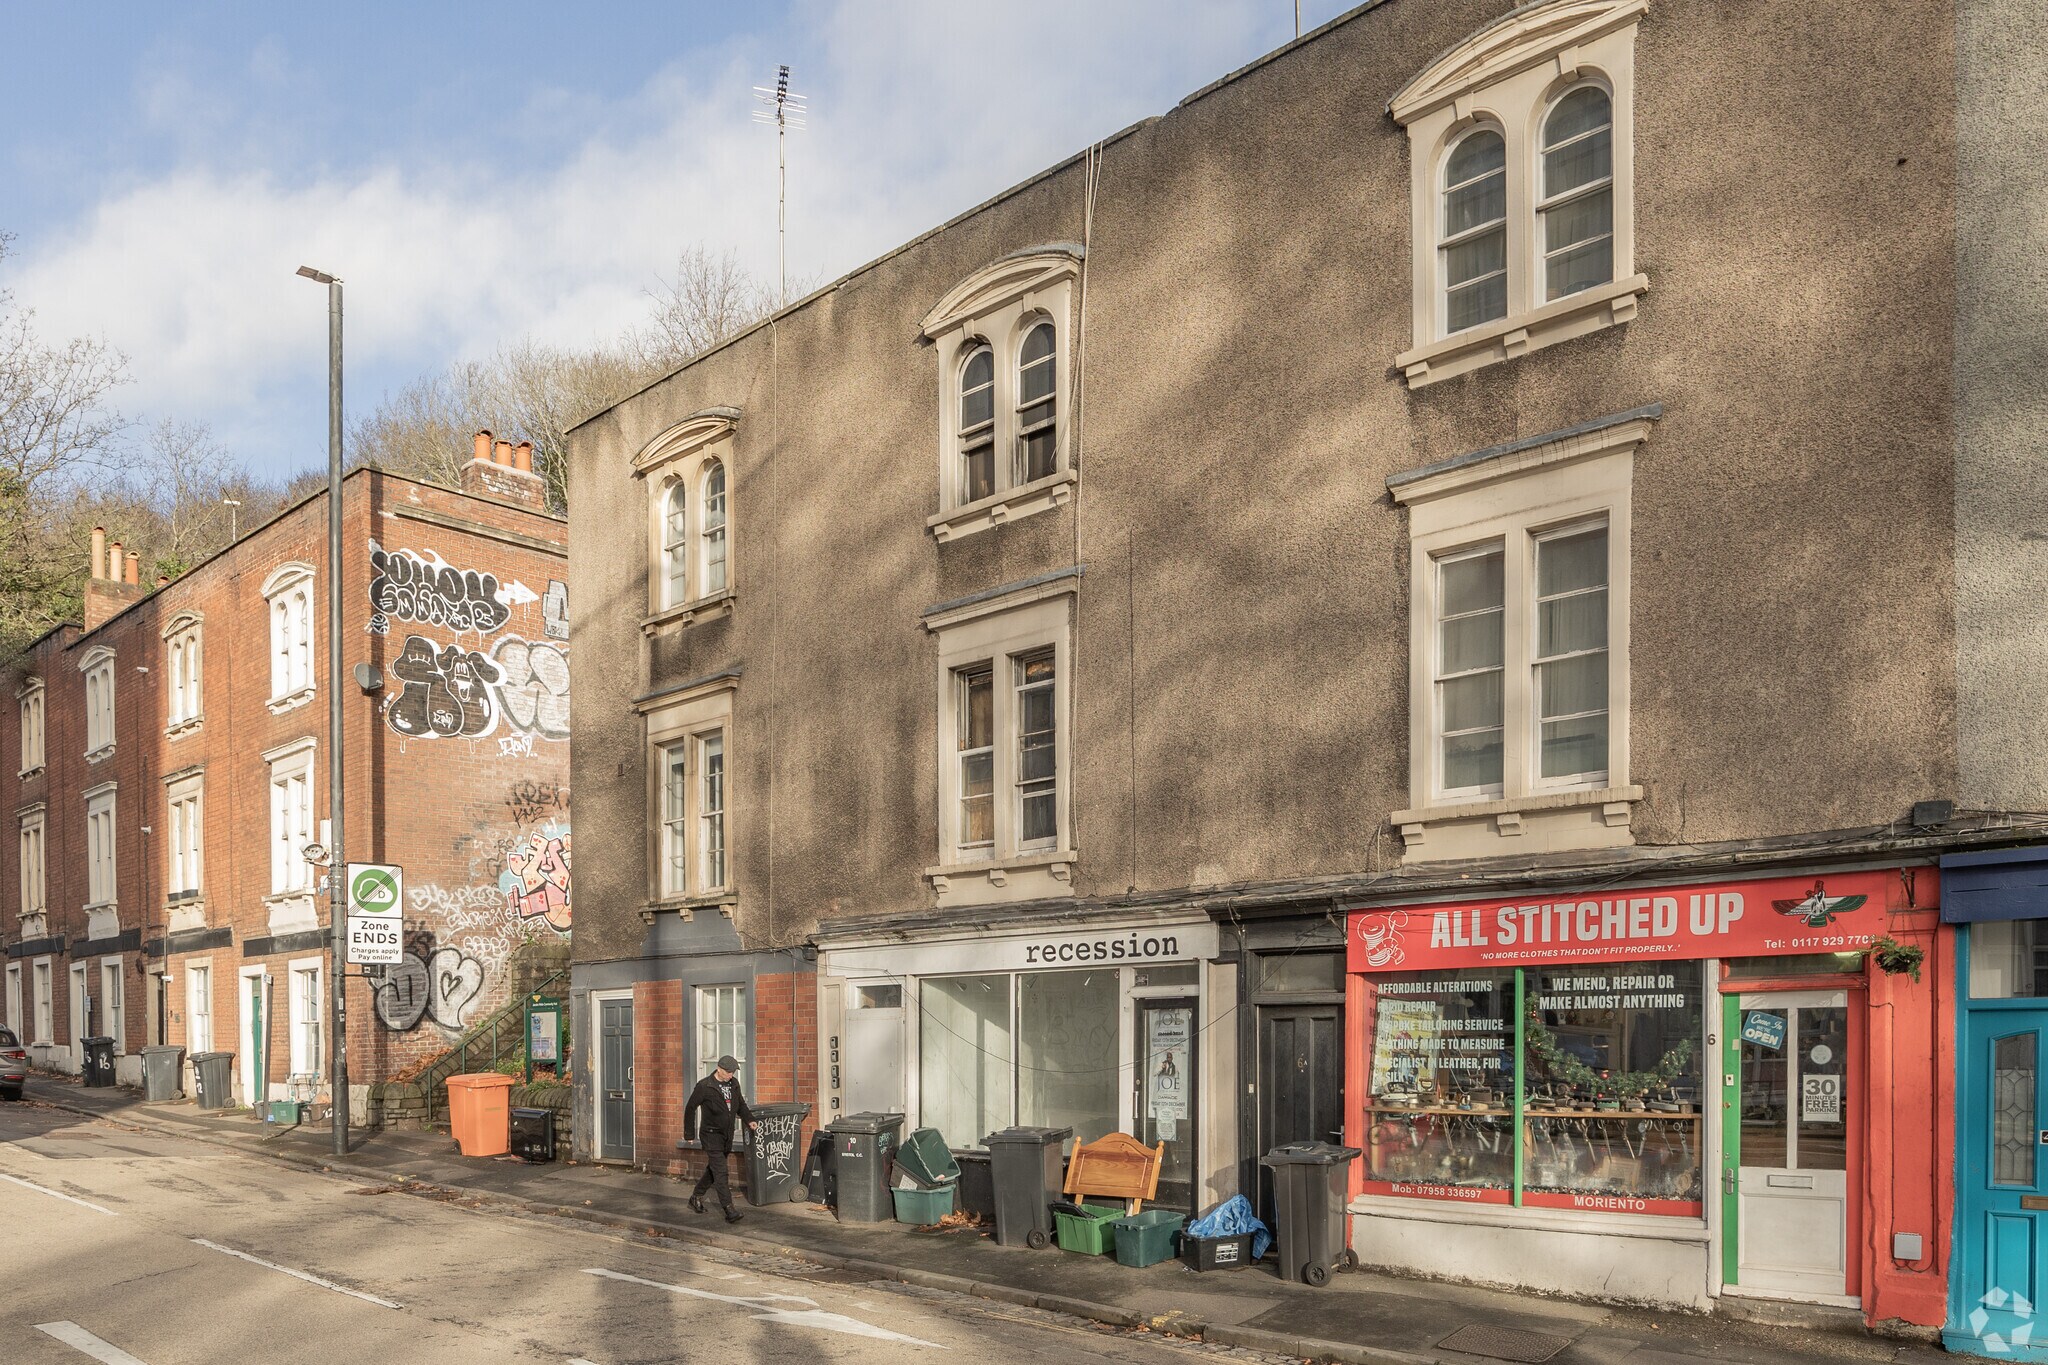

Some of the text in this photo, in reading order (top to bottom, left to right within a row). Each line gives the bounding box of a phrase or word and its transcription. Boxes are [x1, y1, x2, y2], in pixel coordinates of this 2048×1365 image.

[379, 890, 386, 899] D
[361, 921, 389, 930] Zone
[1430, 892, 1744, 948] ALL STITCHED UP
[353, 933, 398, 944] ENDS
[1764, 939, 1786, 948] Tel:
[1792, 937, 1819, 947] 0117
[1822, 936, 1844, 946] 929
[1026, 933, 1179, 963] recession
[1495, 951, 1519, 959] MORE
[1520, 950, 1558, 958] CLOTHES
[1560, 948, 1582, 956] THAT
[1582, 947, 1609, 955] DON'T
[1610, 946, 1623, 954] FIT
[1378, 980, 1493, 994] AFFORDABLE ALTERATIONS
[1552, 974, 1675, 992] WE MEND, REPAIR OR
[1405, 1001, 1436, 1012] REPAIR
[1539, 993, 1684, 1010] MAKE ALMOST ANYTHING
[1157, 1012, 1182, 1028] JOE
[1417, 1019, 1463, 1031] TAILORING
[1464, 1019, 1504, 1030] SERVICE
[1751, 1014, 1783, 1030] Come In
[1707, 1033, 1716, 1046] 6
[1745, 1028, 1779, 1045] OPEN
[1419, 1039, 1446, 1050] MADE
[1447, 1039, 1460, 1050] TO
[1461, 1038, 1505, 1050] MEASURE
[99, 1056, 110, 1069] 16
[1439, 1058, 1481, 1070] LEATHER,
[1483, 1058, 1501, 1069] FUR
[1156, 1074, 1180, 1092] JOE
[1806, 1079, 1836, 1095] 30
[1806, 1100, 1837, 1108] FREE
[1391, 1183, 1482, 1198] Mob: 07958 336597
[1574, 1196, 1646, 1211] MORIENTO
